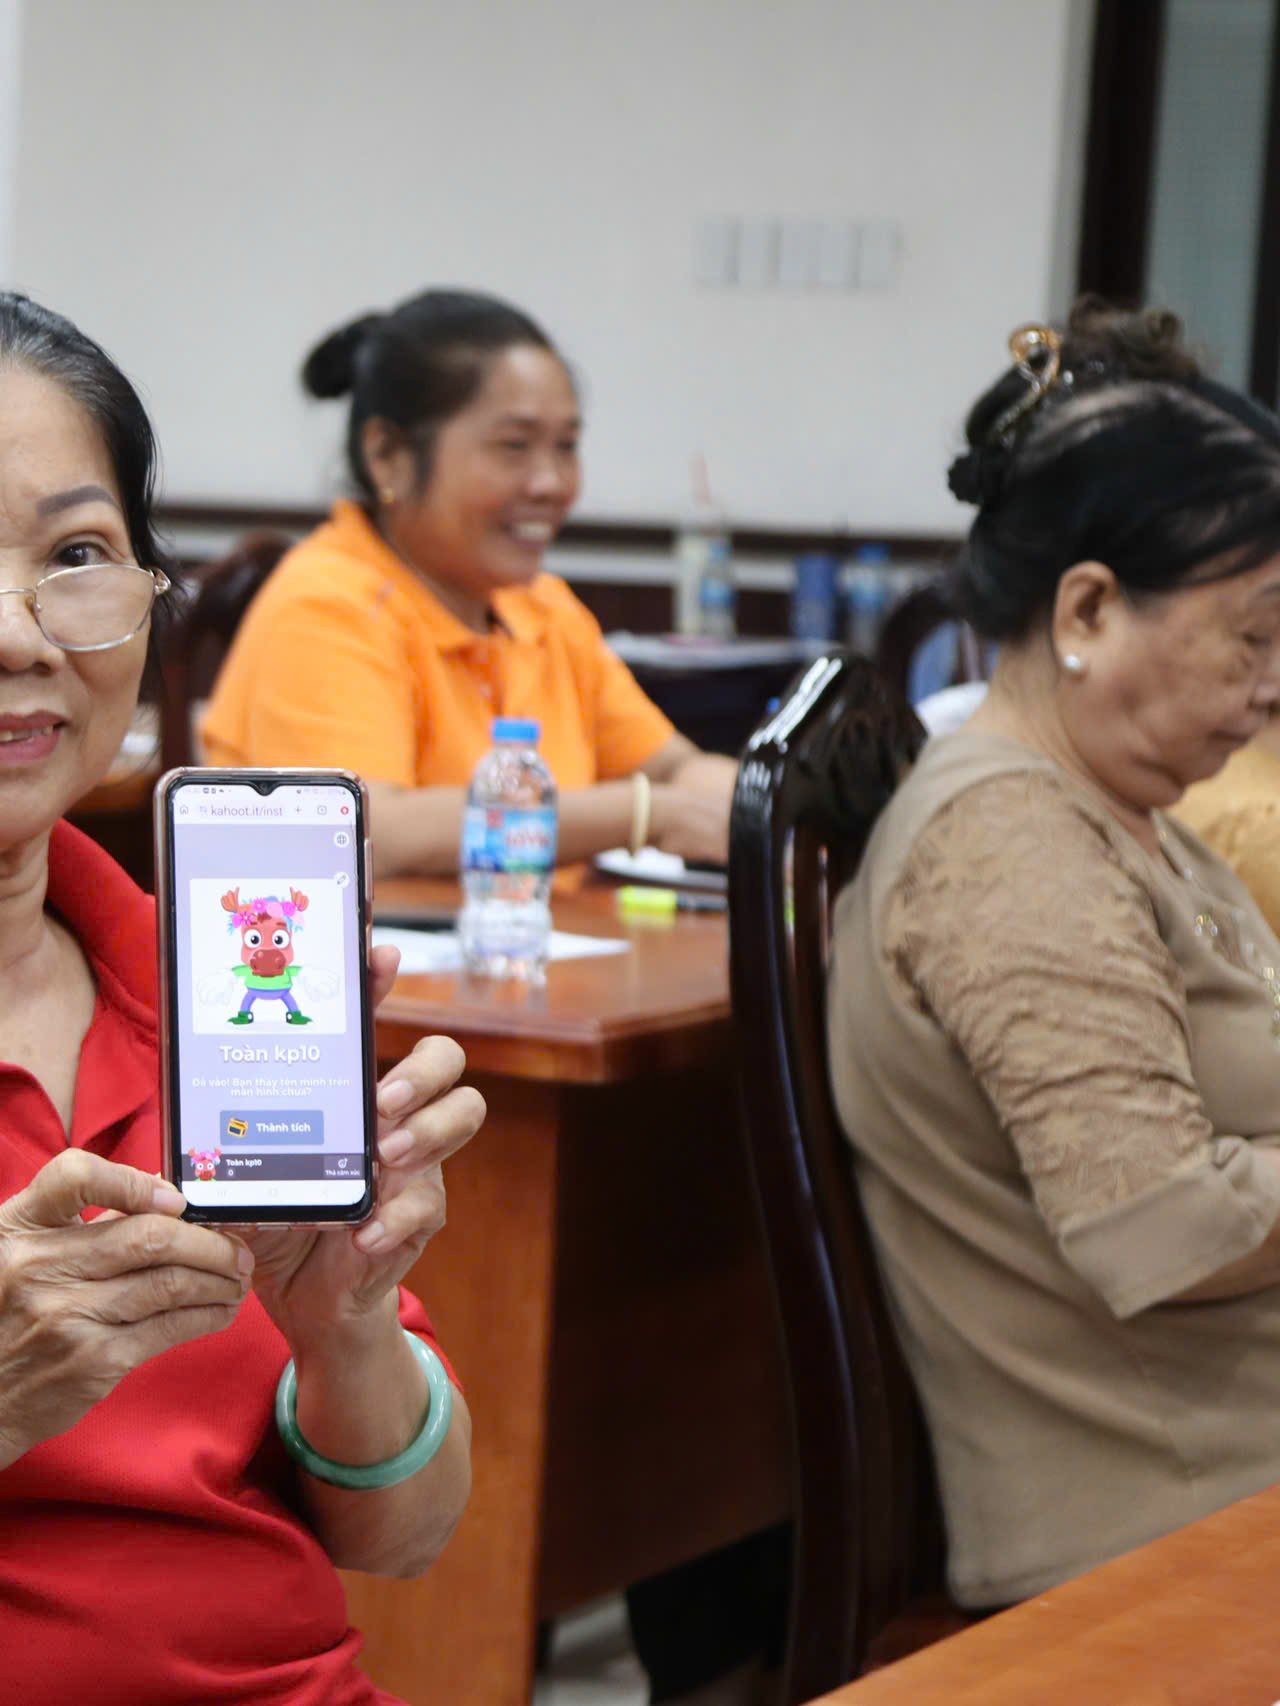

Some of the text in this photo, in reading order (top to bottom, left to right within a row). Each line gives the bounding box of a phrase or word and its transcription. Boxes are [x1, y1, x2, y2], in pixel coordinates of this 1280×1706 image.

[210, 805, 284, 818] kahoot.it/inst
[219, 1044, 321, 1065] Toàn kp10
[255, 1121, 311, 1133] Thành tích
